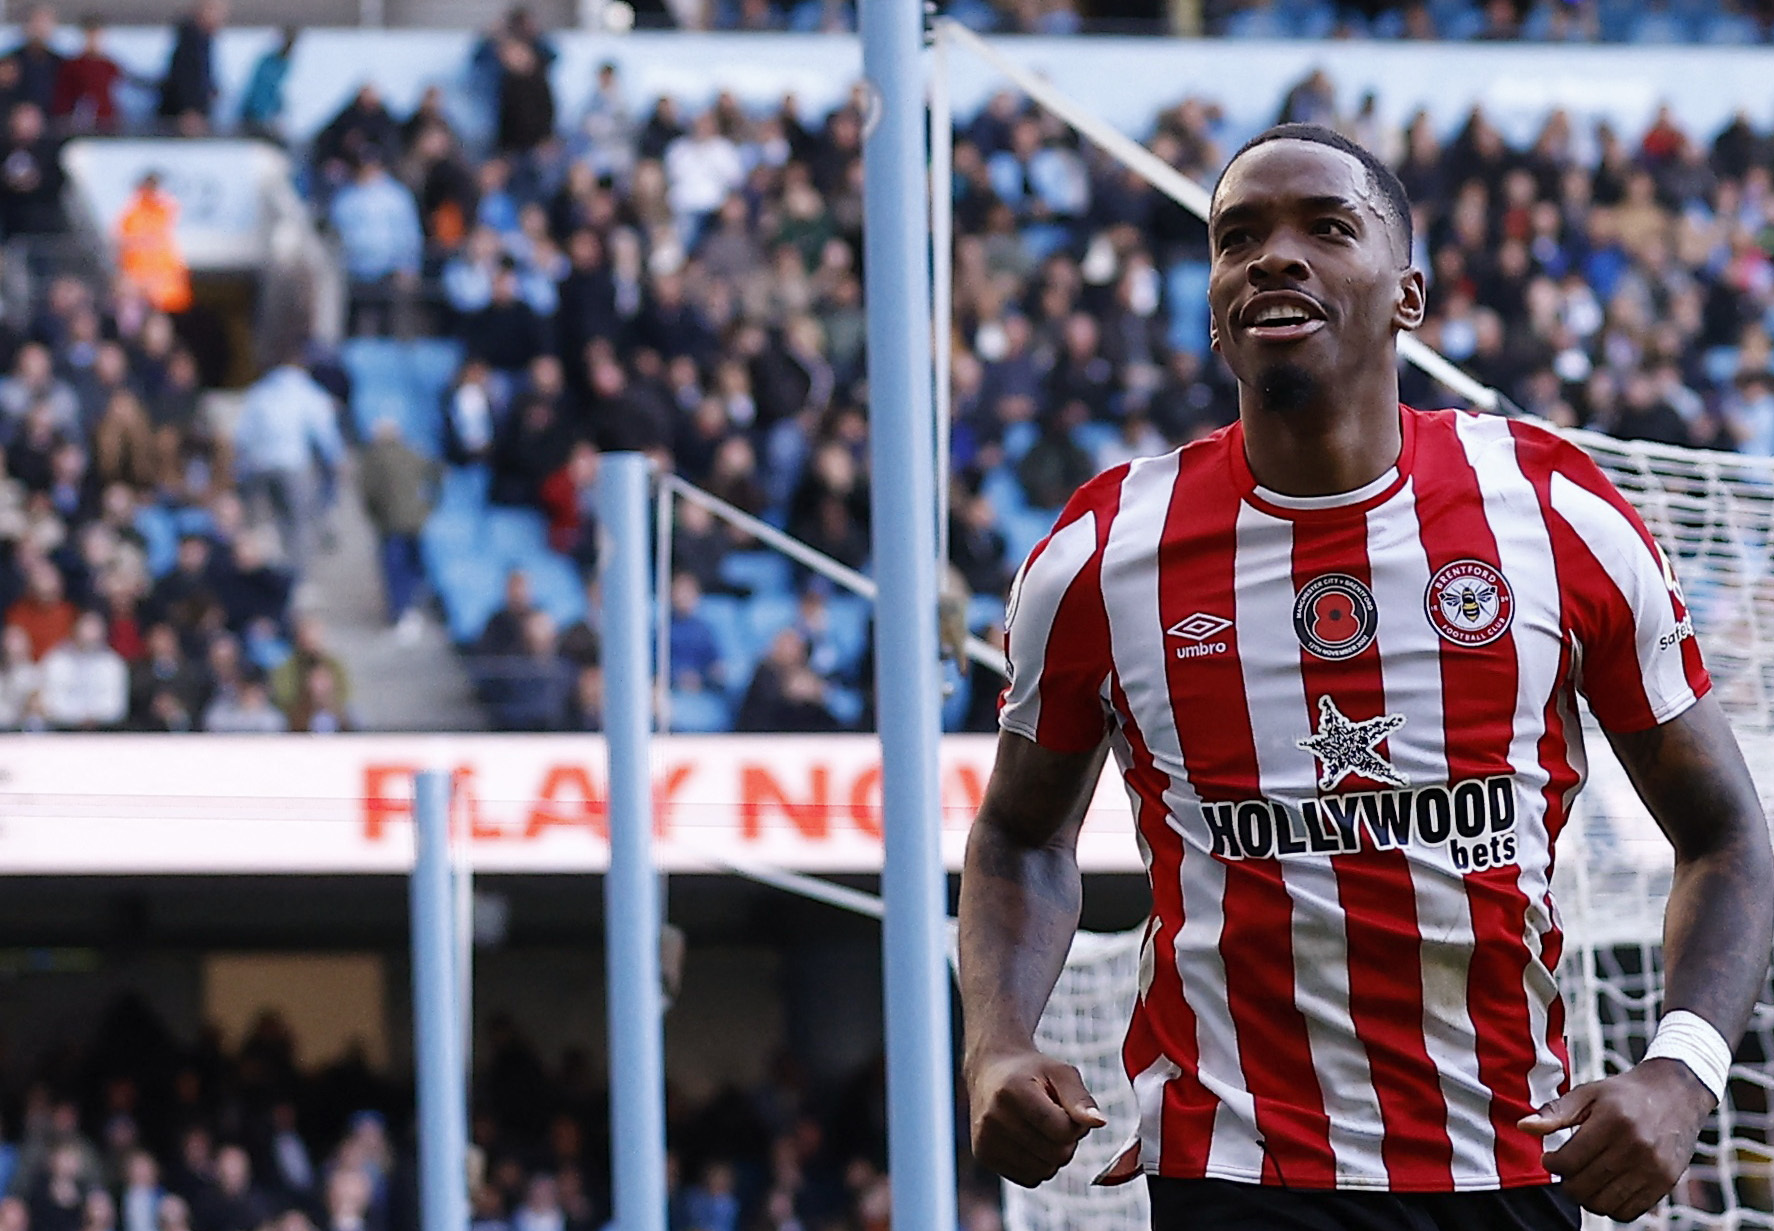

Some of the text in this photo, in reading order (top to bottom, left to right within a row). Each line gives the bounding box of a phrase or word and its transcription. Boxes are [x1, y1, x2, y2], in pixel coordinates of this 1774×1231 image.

[1435, 566, 1496, 589] BRENTFORD
[1296, 580, 1323, 619] MANCHESTER
[1344, 580, 1374, 611] BRENTFORD
[1442, 617, 1506, 641] FOOTBALL CLUB
[1176, 642, 1226, 659] umbro
[1322, 645, 1358, 657] NOVEMBER
[1200, 777, 1516, 858] HOLLYWOOD
[1450, 835, 1516, 870] bets
